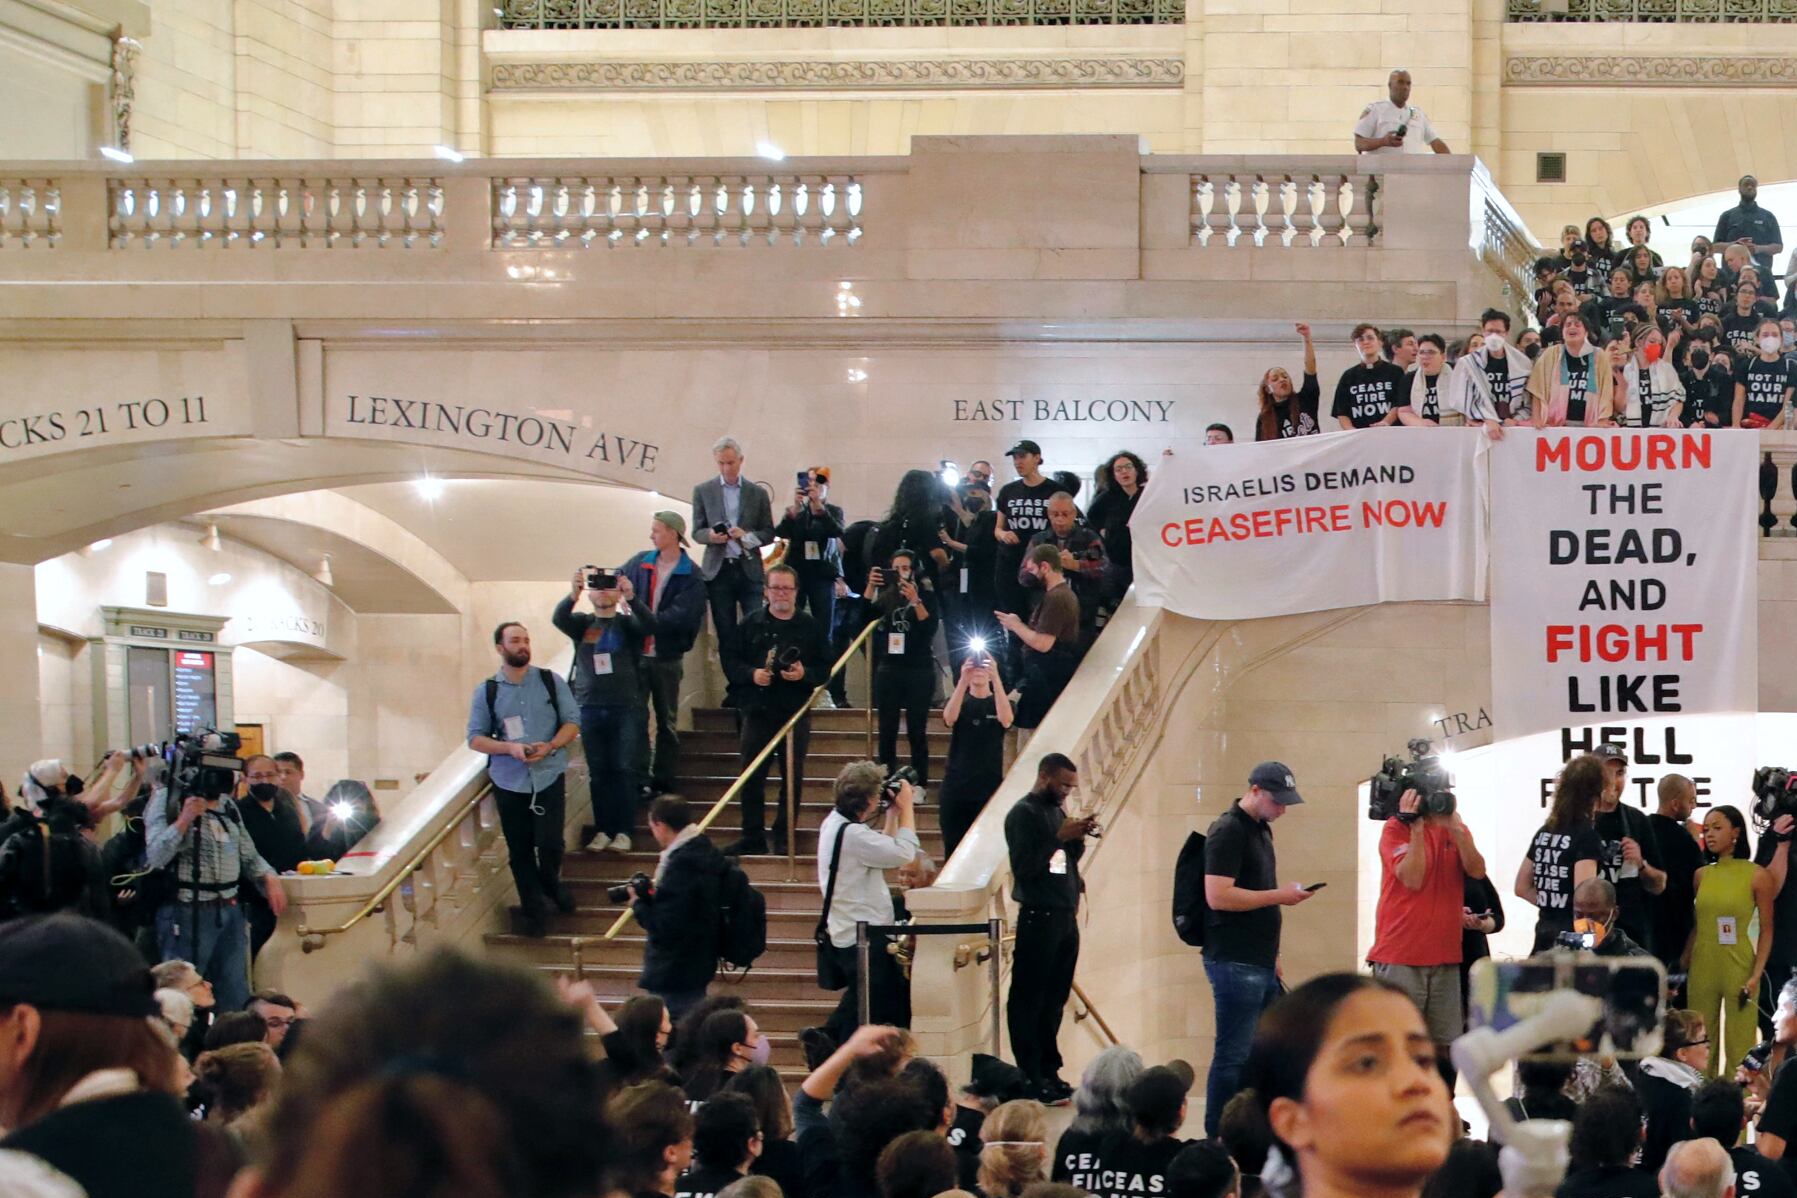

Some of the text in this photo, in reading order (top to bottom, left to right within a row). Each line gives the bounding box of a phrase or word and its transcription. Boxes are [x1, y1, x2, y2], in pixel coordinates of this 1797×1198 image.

[1350, 381, 1392, 395] CEASE
[1488, 373, 1503, 381] OT
[1748, 373, 1787, 383] NOT IN
[1751, 383, 1783, 393] OUR
[1356, 391, 1387, 404] FIRE
[76, 408, 109, 437] 21
[118, 397, 169, 429] TO
[953, 400, 1176, 422] EAST BALCONY
[1351, 403, 1392, 419] NOW
[347, 395, 660, 474] LEXINGTON AVE
[1536, 434, 1711, 472] MOURN
[1184, 465, 1415, 504] ISRAELIS DEMAND
[1007, 498, 1050, 508] CEASE
[1582, 483, 1663, 515] THE
[1011, 507, 1043, 516] FIRE
[1008, 516, 1048, 530] NOW
[1161, 499, 1447, 548] CEASEFIRE NOW
[1550, 529, 1697, 566] DEAD,
[1578, 578, 1666, 611] AND
[1546, 624, 1703, 662] FIGHT
[1568, 674, 1682, 712] LIKE
[1561, 727, 1693, 765] HELL
[1632, 777, 1712, 808] TE
[1535, 832, 1571, 850] JEWS
[1535, 848, 1562, 865] SAY
[1532, 862, 1569, 879] EASE
[1534, 876, 1560, 892] IRE
[1101, 1170, 1165, 1193] CEAS
